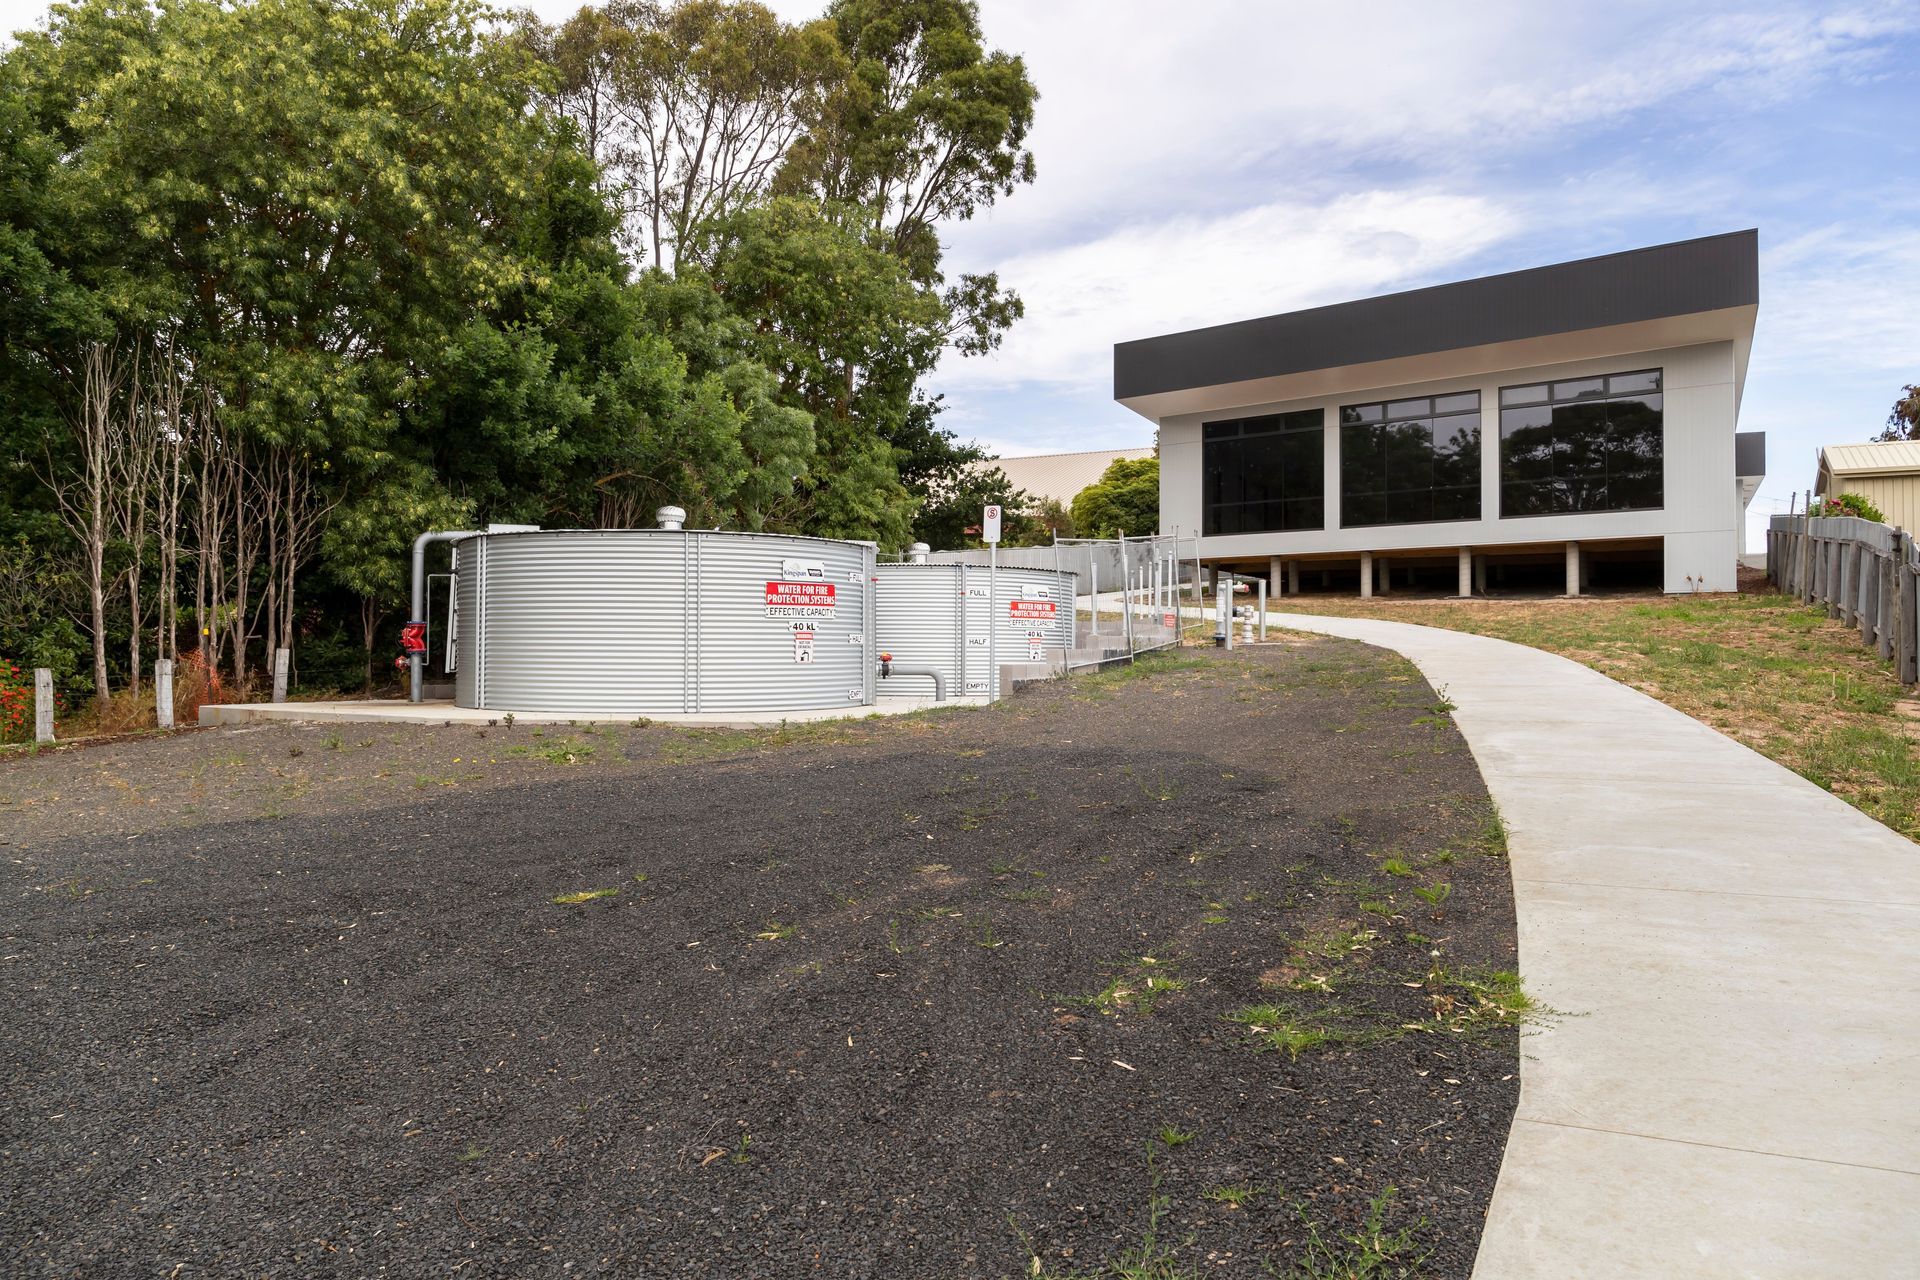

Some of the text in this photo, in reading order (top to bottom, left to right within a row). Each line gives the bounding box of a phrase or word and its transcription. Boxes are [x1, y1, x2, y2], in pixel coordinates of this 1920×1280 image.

[777, 584, 828, 595] WATER FOR FIRE
[767, 594, 835, 605] PROTECTION SYSTEMS
[1017, 602, 1034, 610] WATER
[1034, 603, 1043, 611] FOR
[769, 607, 833, 617] EFFECTIVE CAPACITY
[793, 622, 816, 631] 40 kL
[966, 682, 988, 690] EMPTY
